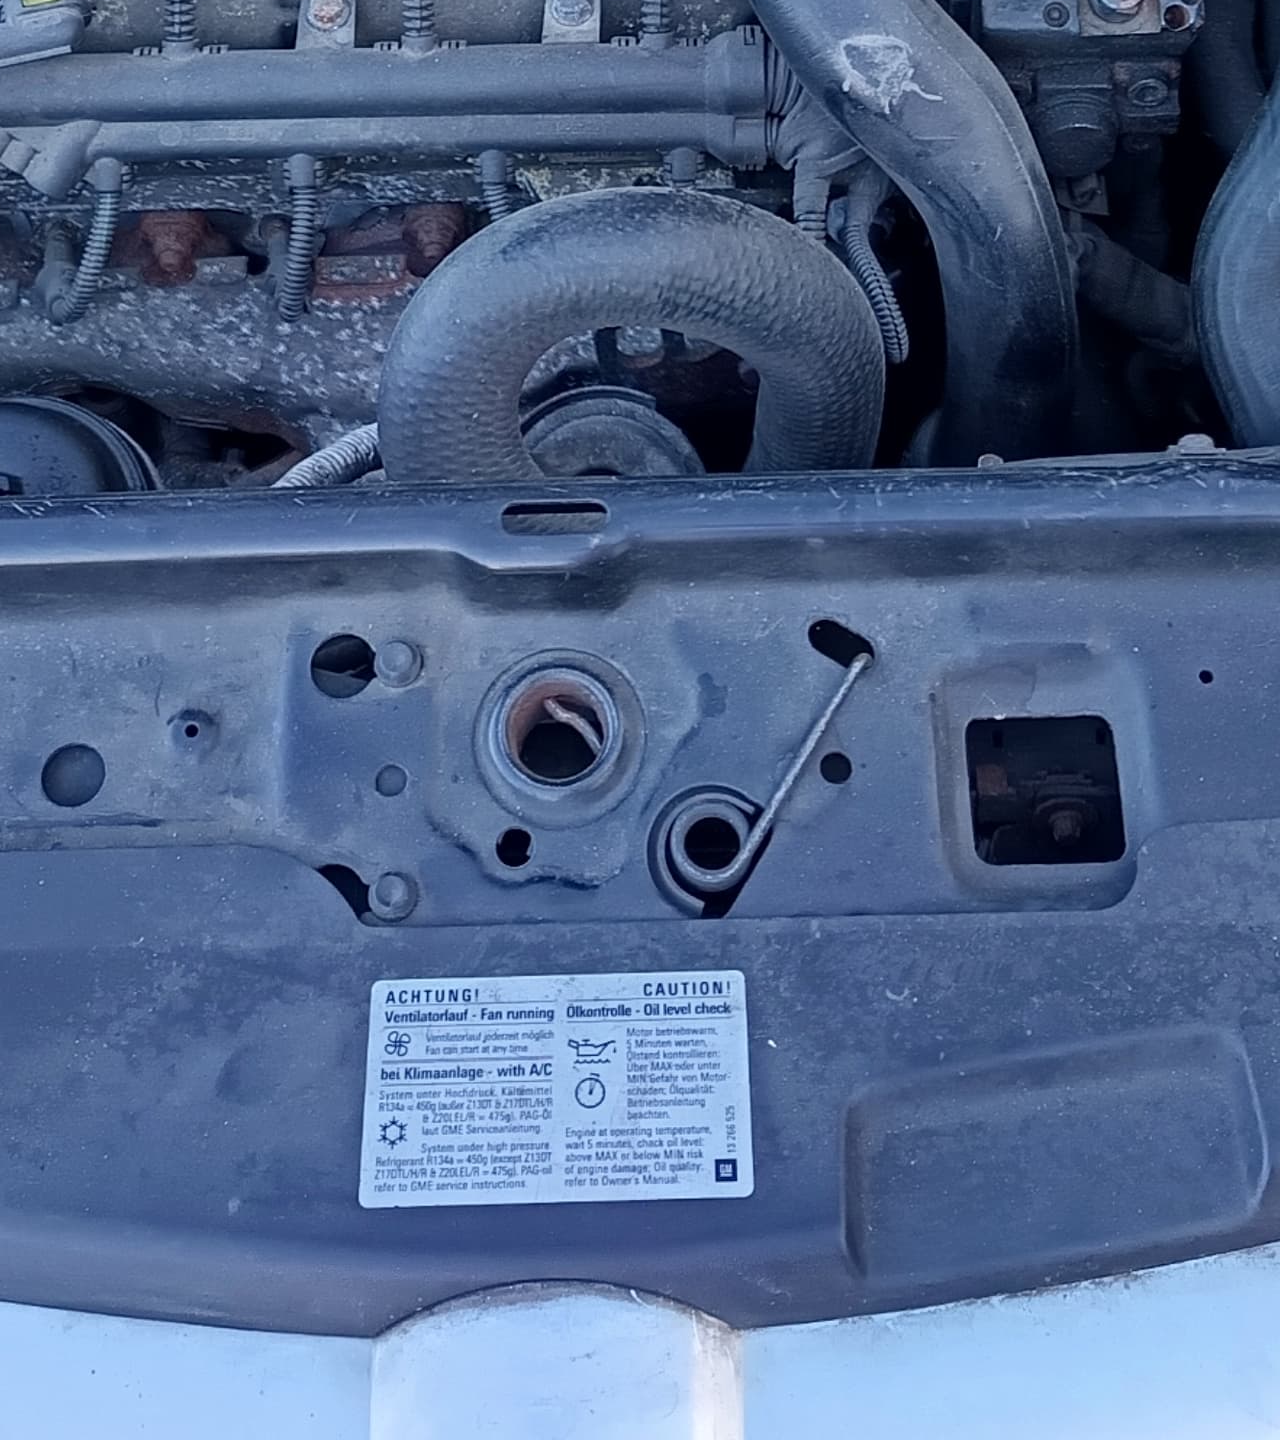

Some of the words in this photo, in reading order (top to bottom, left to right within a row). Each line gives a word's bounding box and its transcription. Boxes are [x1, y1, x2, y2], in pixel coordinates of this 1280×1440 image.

[643, 982, 730, 996] CAUTION!
[385, 989, 479, 1003] ACHTUNG!
[644, 1003, 659, 1015] Oil
[663, 1003, 691, 1015] level
[695, 1002, 732, 1014] check
[385, 1009, 468, 1023] Ventilatorlauf
[481, 1008, 502, 1020] Fan
[507, 1007, 554, 1021] running
[426, 1046, 440, 1055] Fan
[461, 1046, 479, 1054] start
[492, 1046, 507, 1054] any
[381, 1068, 400, 1080] bei
[404, 1066, 484, 1080] Klimaanlage
[498, 1066, 525, 1076] with
[529, 1063, 552, 1076] A/C
[684, 1074, 697, 1082] von
[379, 1090, 413, 1102] System
[566, 1127, 595, 1139] Engine
[599, 1128, 607, 1136] at
[610, 1128, 653, 1137] operating
[421, 1143, 455, 1154] System
[458, 1143, 484, 1152] under
[587, 1141, 593, 1149] 5
[667, 1138, 677, 1147] oil
[565, 1154, 592, 1163] above
[595, 1152, 618, 1161] MAX
[633, 1150, 660, 1160] below
[664, 1150, 684, 1159] MIN
[687, 1150, 703, 1158] risk
[565, 1165, 574, 1174] of
[577, 1165, 608, 1175] engine
[654, 1162, 666, 1171] Oil
[374, 1183, 395, 1192] refer
[398, 1183, 407, 1191] to
[410, 1181, 432, 1191] GME
[436, 1181, 468, 1190] service
[564, 1177, 587, 1187] refer
[590, 1177, 598, 1186] to
